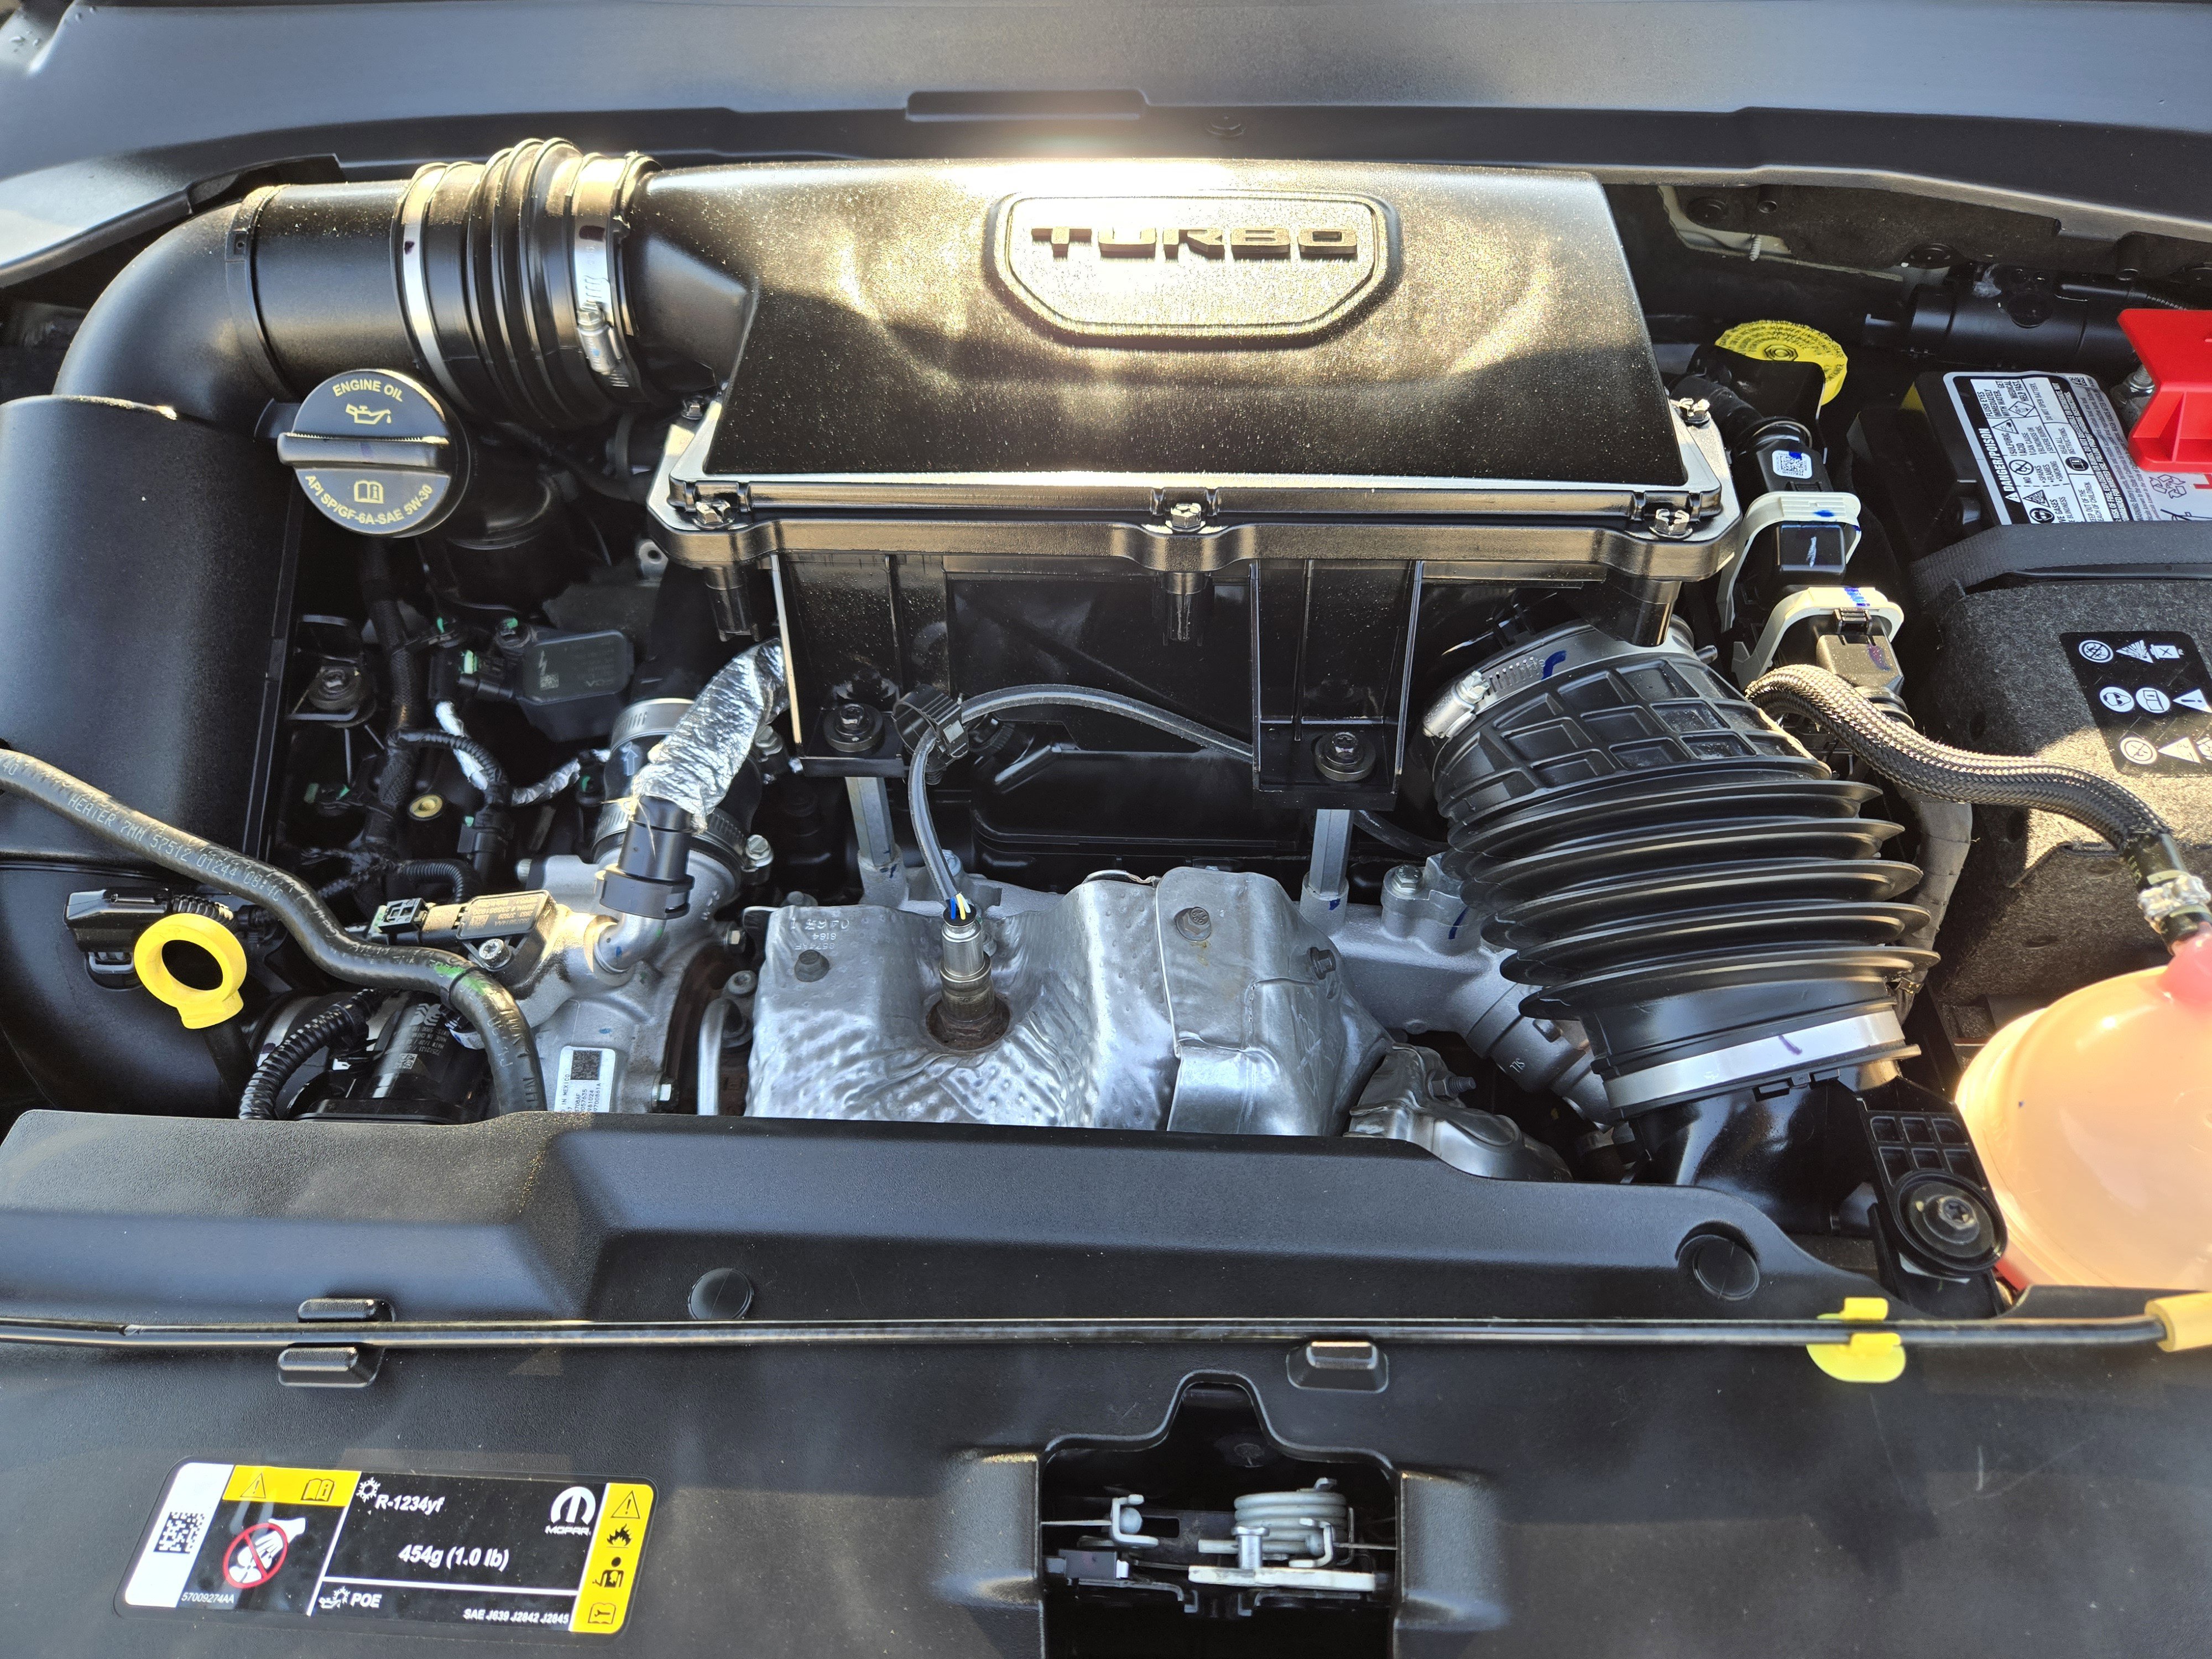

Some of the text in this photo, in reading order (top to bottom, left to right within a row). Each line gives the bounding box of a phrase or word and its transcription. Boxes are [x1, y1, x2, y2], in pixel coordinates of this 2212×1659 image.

[1030, 227, 1358, 260] TURBO
[333, 379, 403, 403] ENGINE OIL
[2003, 380, 2018, 398] MEDICAL
[2017, 392, 2030, 401] HELP
[1976, 392, 1994, 416] FLUSH EYES
[1983, 389, 2002, 416] IMMEDIATELY
[2036, 399, 2047, 407] OPEN
[1999, 406, 2010, 416] WITH
[2001, 432, 2017, 453] SULFURIC
[2021, 432, 2032, 444] CAUSE
[2030, 433, 2046, 451] BLINDNESS
[2041, 437, 2054, 451] SEVERE
[2015, 442, 2028, 453] ACID
[2057, 445, 2068, 453] READ
[2090, 447, 2104, 461] FOLLOW
[1978, 428, 2015, 491] DANGER/POISON
[2094, 471, 2111, 491] EXPLOSION
[2102, 471, 2117, 487] INVERTED
[305, 475, 433, 525] API SP/GF-6A-SAE 5W-30
[2049, 499, 2063, 514] GASES
[2058, 497, 2074, 518] BLINDNESS
[2110, 509, 2120, 518] RISK
[67, 793, 118, 828] HEATER
[119, 820, 149, 842] 7MM
[149, 834, 192, 863] 57512
[196, 852, 241, 880] 01244
[374, 1494, 445, 1515] R-1234yf
[545, 1525, 590, 1536] MOPAR
[398, 1544, 509, 1572] 454g (1.0 lb)
[181, 1592, 234, 1604] 57009274AA
[350, 1593, 382, 1608] POE
[462, 1608, 570, 1624] SAE J639 J2842 J2845
